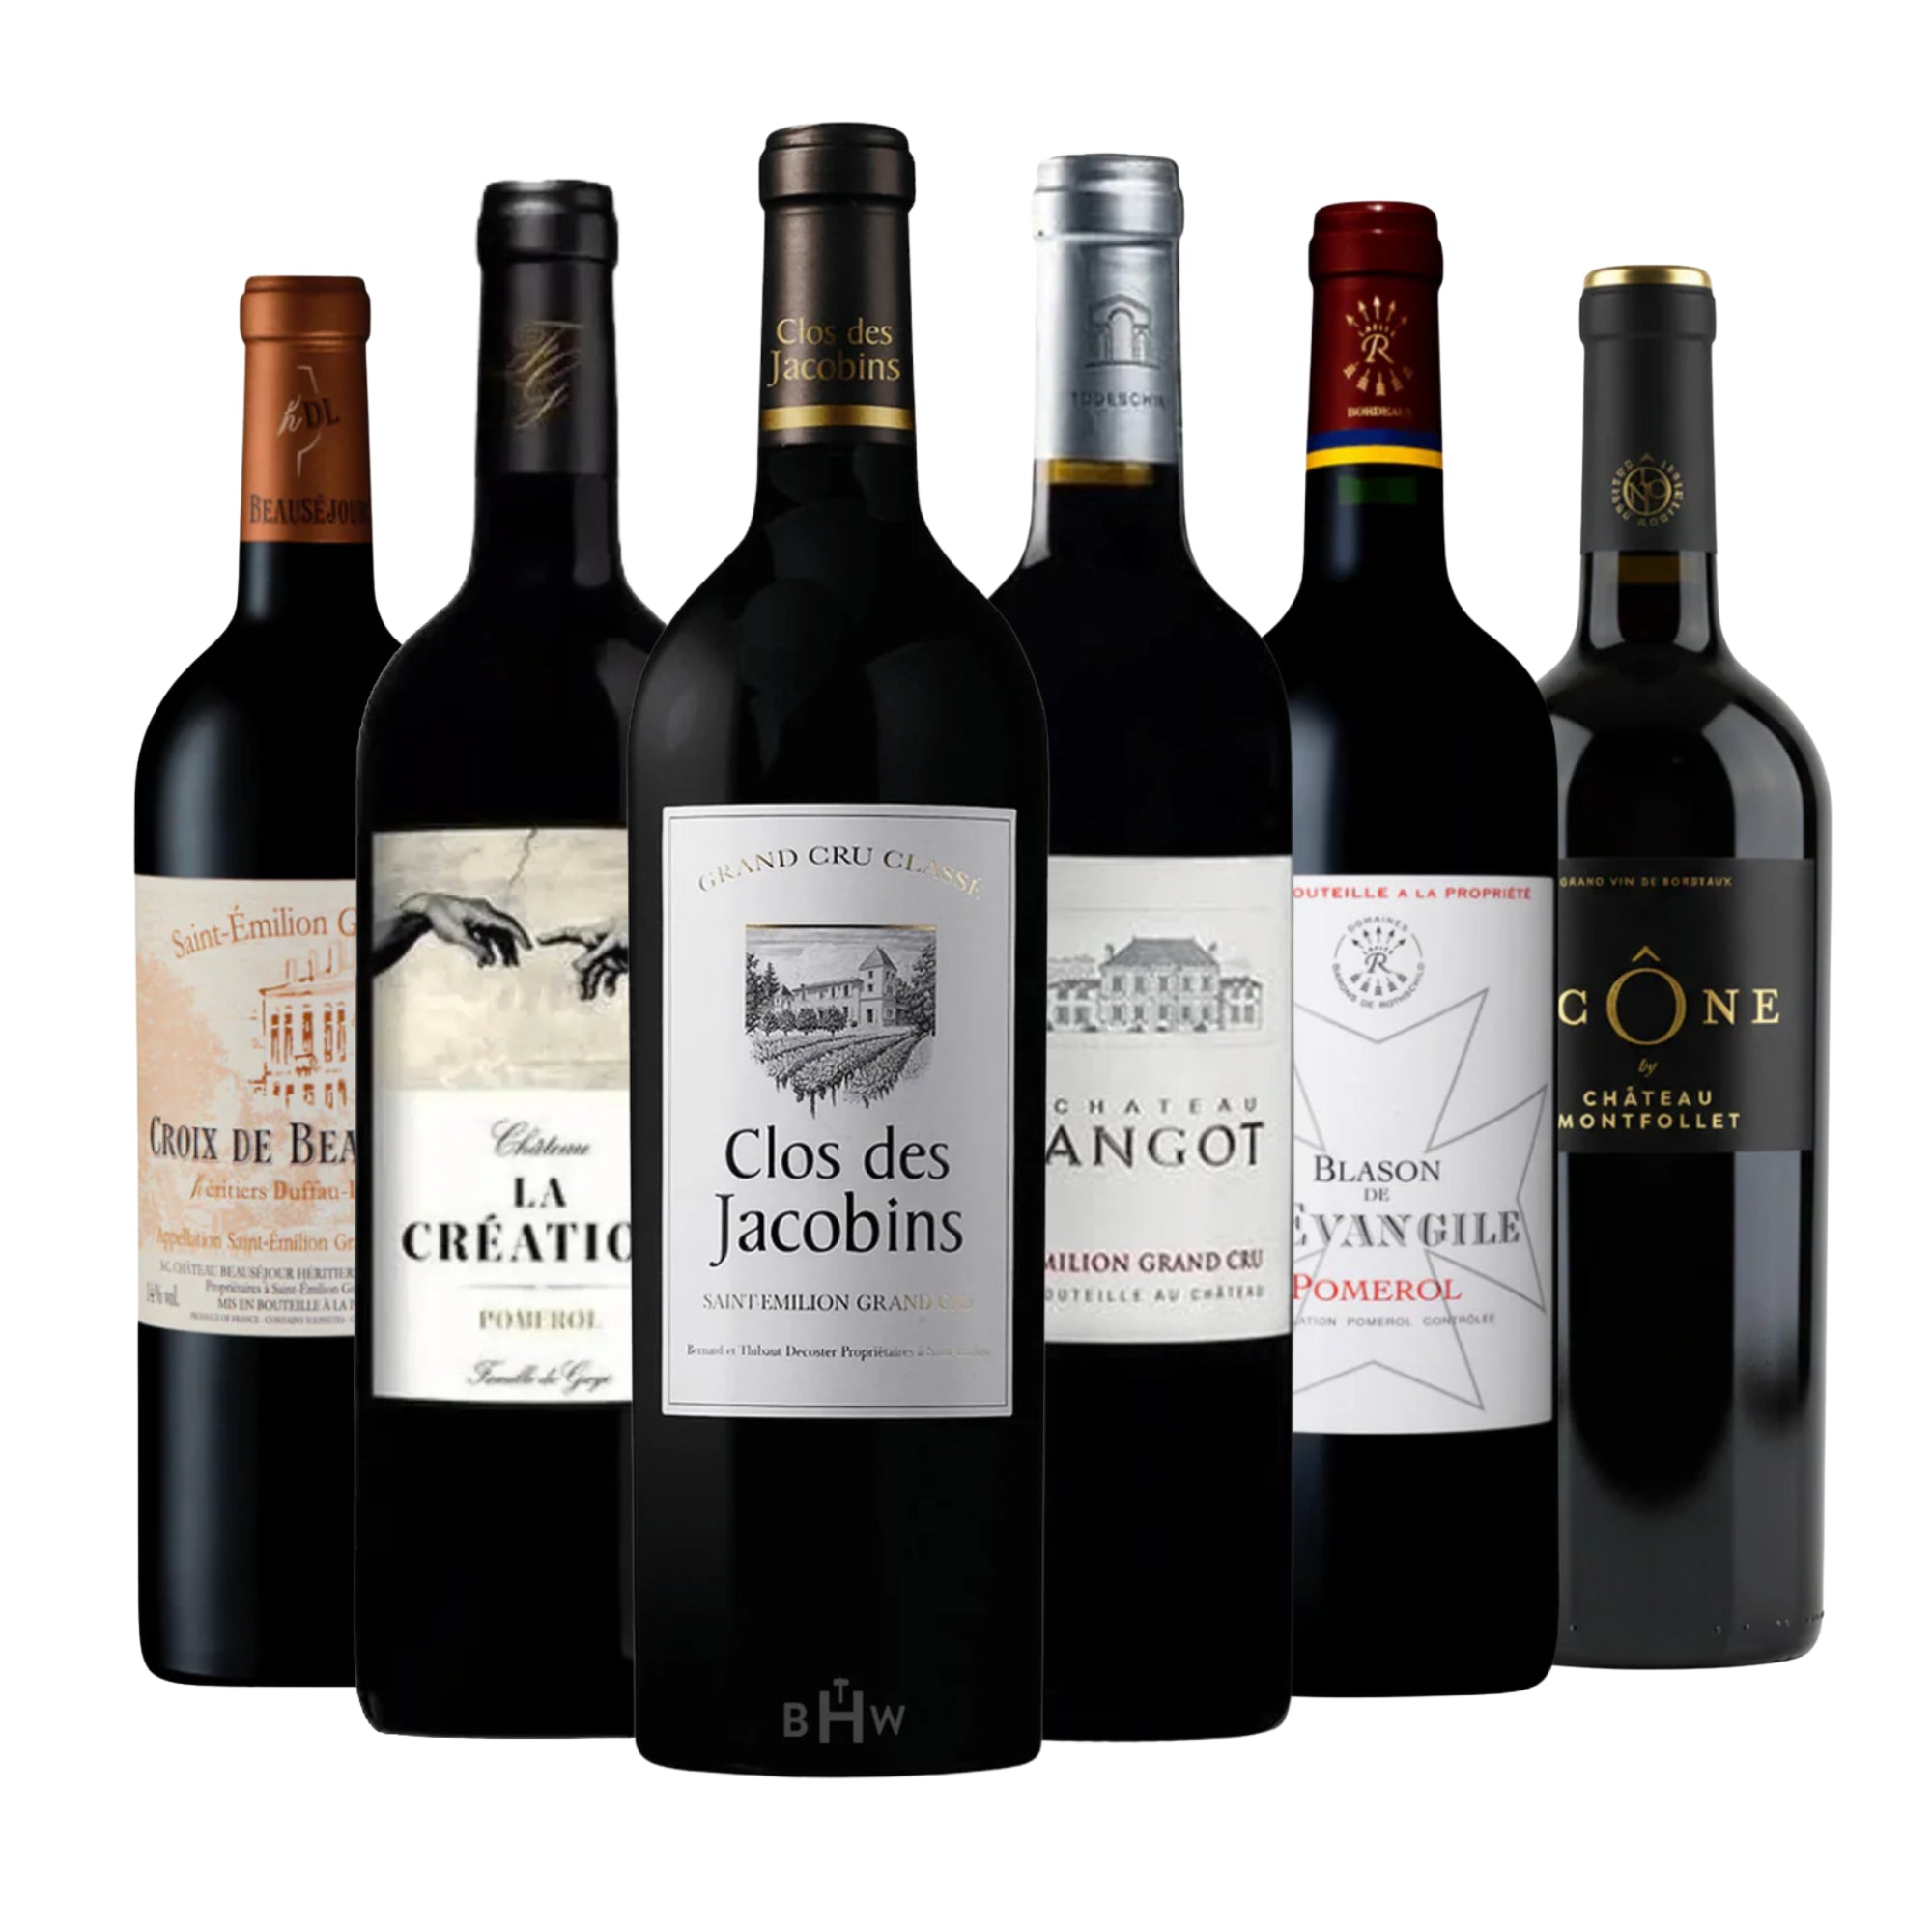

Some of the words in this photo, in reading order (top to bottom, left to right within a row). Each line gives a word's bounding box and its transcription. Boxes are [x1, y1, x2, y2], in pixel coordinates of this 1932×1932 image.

[776, 317, 837, 345] Clos
[847, 317, 894, 345] des
[766, 349, 901, 388] Jacobins
[697, 848, 799, 893] GRAND
[808, 845, 873, 867] CRU
[1398, 888, 1408, 898] A
[1415, 887, 1437, 898] LA
[1445, 887, 1532, 899] PROPRIÉTÉ
[1560, 876, 1605, 888] GRAND
[1610, 876, 1634, 887] VIN
[1642, 876, 1657, 887] DE
[171, 904, 327, 958] Saint-Émilion
[1638, 1059, 1658, 1078] by
[1054, 1098, 1258, 1115] CHATEAU
[1582, 1086, 1713, 1107] CHÂTEAU
[1558, 1114, 1740, 1130] MONTFOLLET
[150, 1116, 218, 1160] CROIX
[232, 1128, 272, 1162] DE
[491, 1118, 591, 1158] Château
[725, 1125, 840, 1179] Clos
[864, 1125, 950, 1179] des
[1314, 1154, 1442, 1183] BLASON
[514, 1176, 567, 1208] LA
[1363, 1187, 1390, 1203] DE
[709, 1190, 963, 1267] Jacobins
[1138, 1252, 1221, 1273] GRAND
[1226, 1250, 1264, 1270] CRU
[1154, 1287, 1180, 1302] AU
[1293, 1273, 1462, 1302] POMEROL
[857, 1293, 933, 1312] GRAND
[479, 1308, 602, 1331] POMEROL
[1347, 1316, 1411, 1327] POMEROL
[786, 1344, 838, 1359] Decoster
[841, 1345, 914, 1362] Propriétaires
